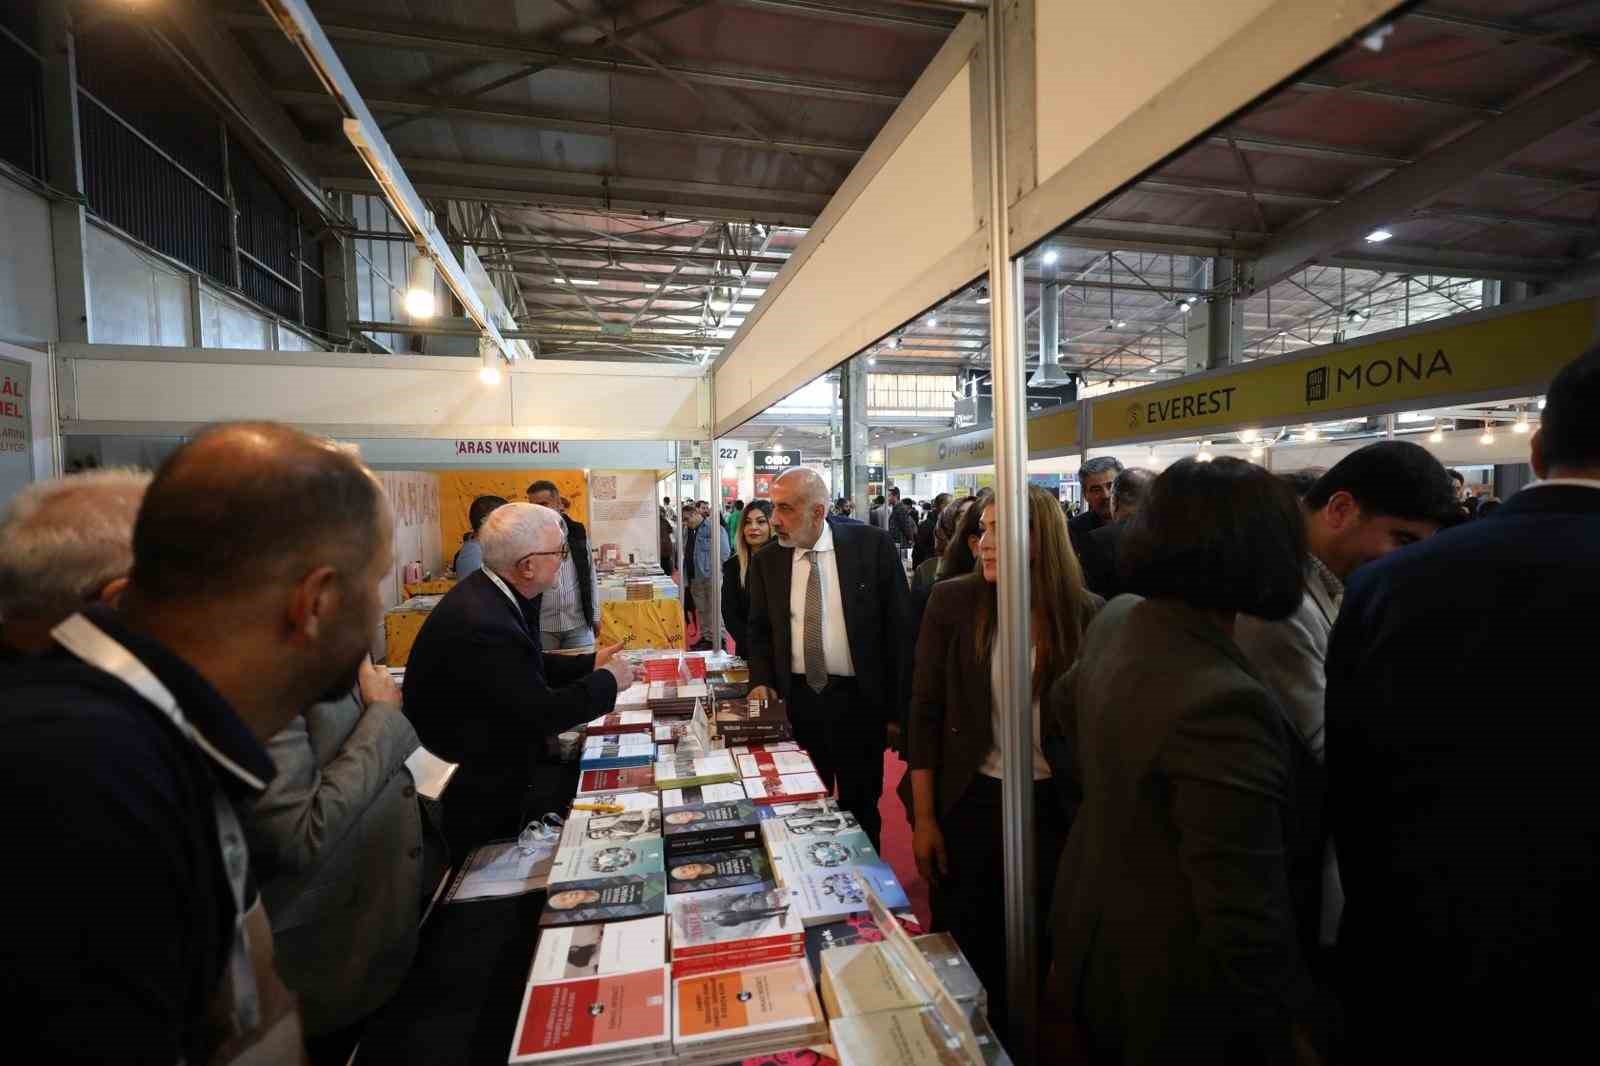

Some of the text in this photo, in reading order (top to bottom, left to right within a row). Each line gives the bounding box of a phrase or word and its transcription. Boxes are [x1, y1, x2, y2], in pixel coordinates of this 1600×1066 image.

[1337, 350, 1452, 393] MONA
[1147, 387, 1236, 424] EVEREST
[496, 441, 560, 454] YAYINCILIK
[719, 448, 738, 459] 227
